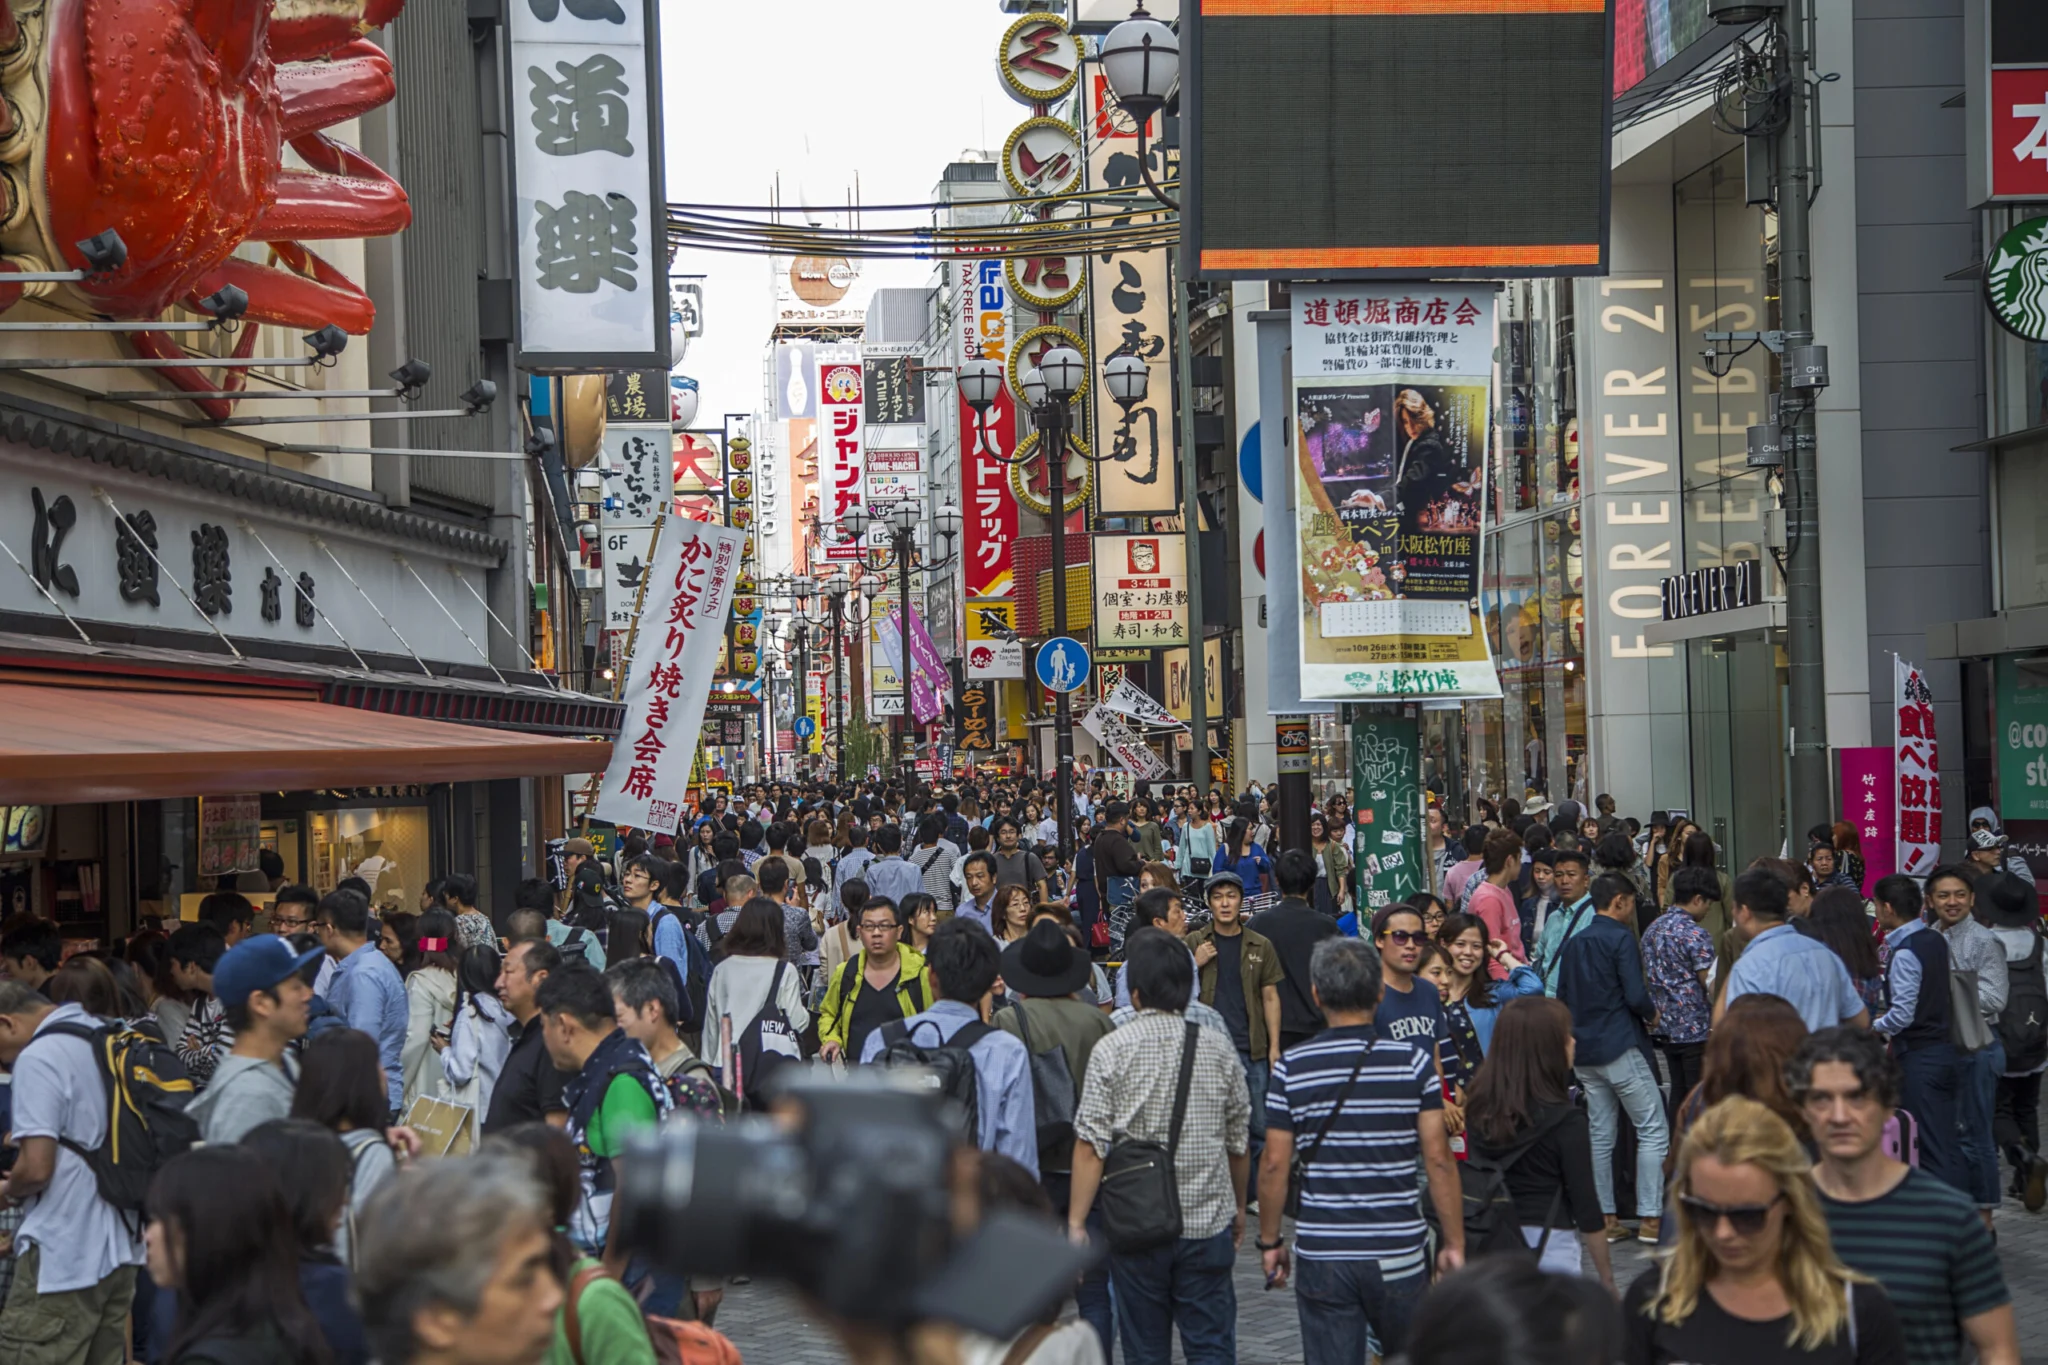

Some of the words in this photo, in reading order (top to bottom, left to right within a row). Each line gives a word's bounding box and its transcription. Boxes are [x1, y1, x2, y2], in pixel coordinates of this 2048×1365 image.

[962, 262, 973, 286] TAX
[963, 290, 976, 323] FREE
[1304, 297, 1482, 327] 道頓堀商店会
[1600, 278, 1665, 334] 21
[1806, 366, 1823, 374] CH1
[624, 372, 647, 419] 農場
[891, 359, 903, 421] インターネット
[1762, 444, 1780, 453] CH4
[1604, 366, 1674, 658] FOREVER
[608, 535, 628, 550] 6F
[1380, 544, 1392, 555] in
[1396, 534, 1472, 556] 大阪松竹座
[705, 541, 732, 614] 特別会席フェア
[1660, 565, 1728, 621] FOREVER
[1736, 560, 1752, 607] 21
[260, 566, 316, 628] 本店
[1102, 590, 1188, 607] 個室・お座敷
[1112, 621, 1184, 639] 寿司・和食
[621, 534, 712, 801] かに炙り焼き会席
[1391, 668, 1462, 694] 松竹座
[882, 699, 904, 709] ZAZ
[960, 689, 992, 749] らーめん
[1862, 773, 1878, 838] 竹本座跡
[761, 1020, 785, 1034] NEW
[1388, 1015, 1436, 1041] BRONX
